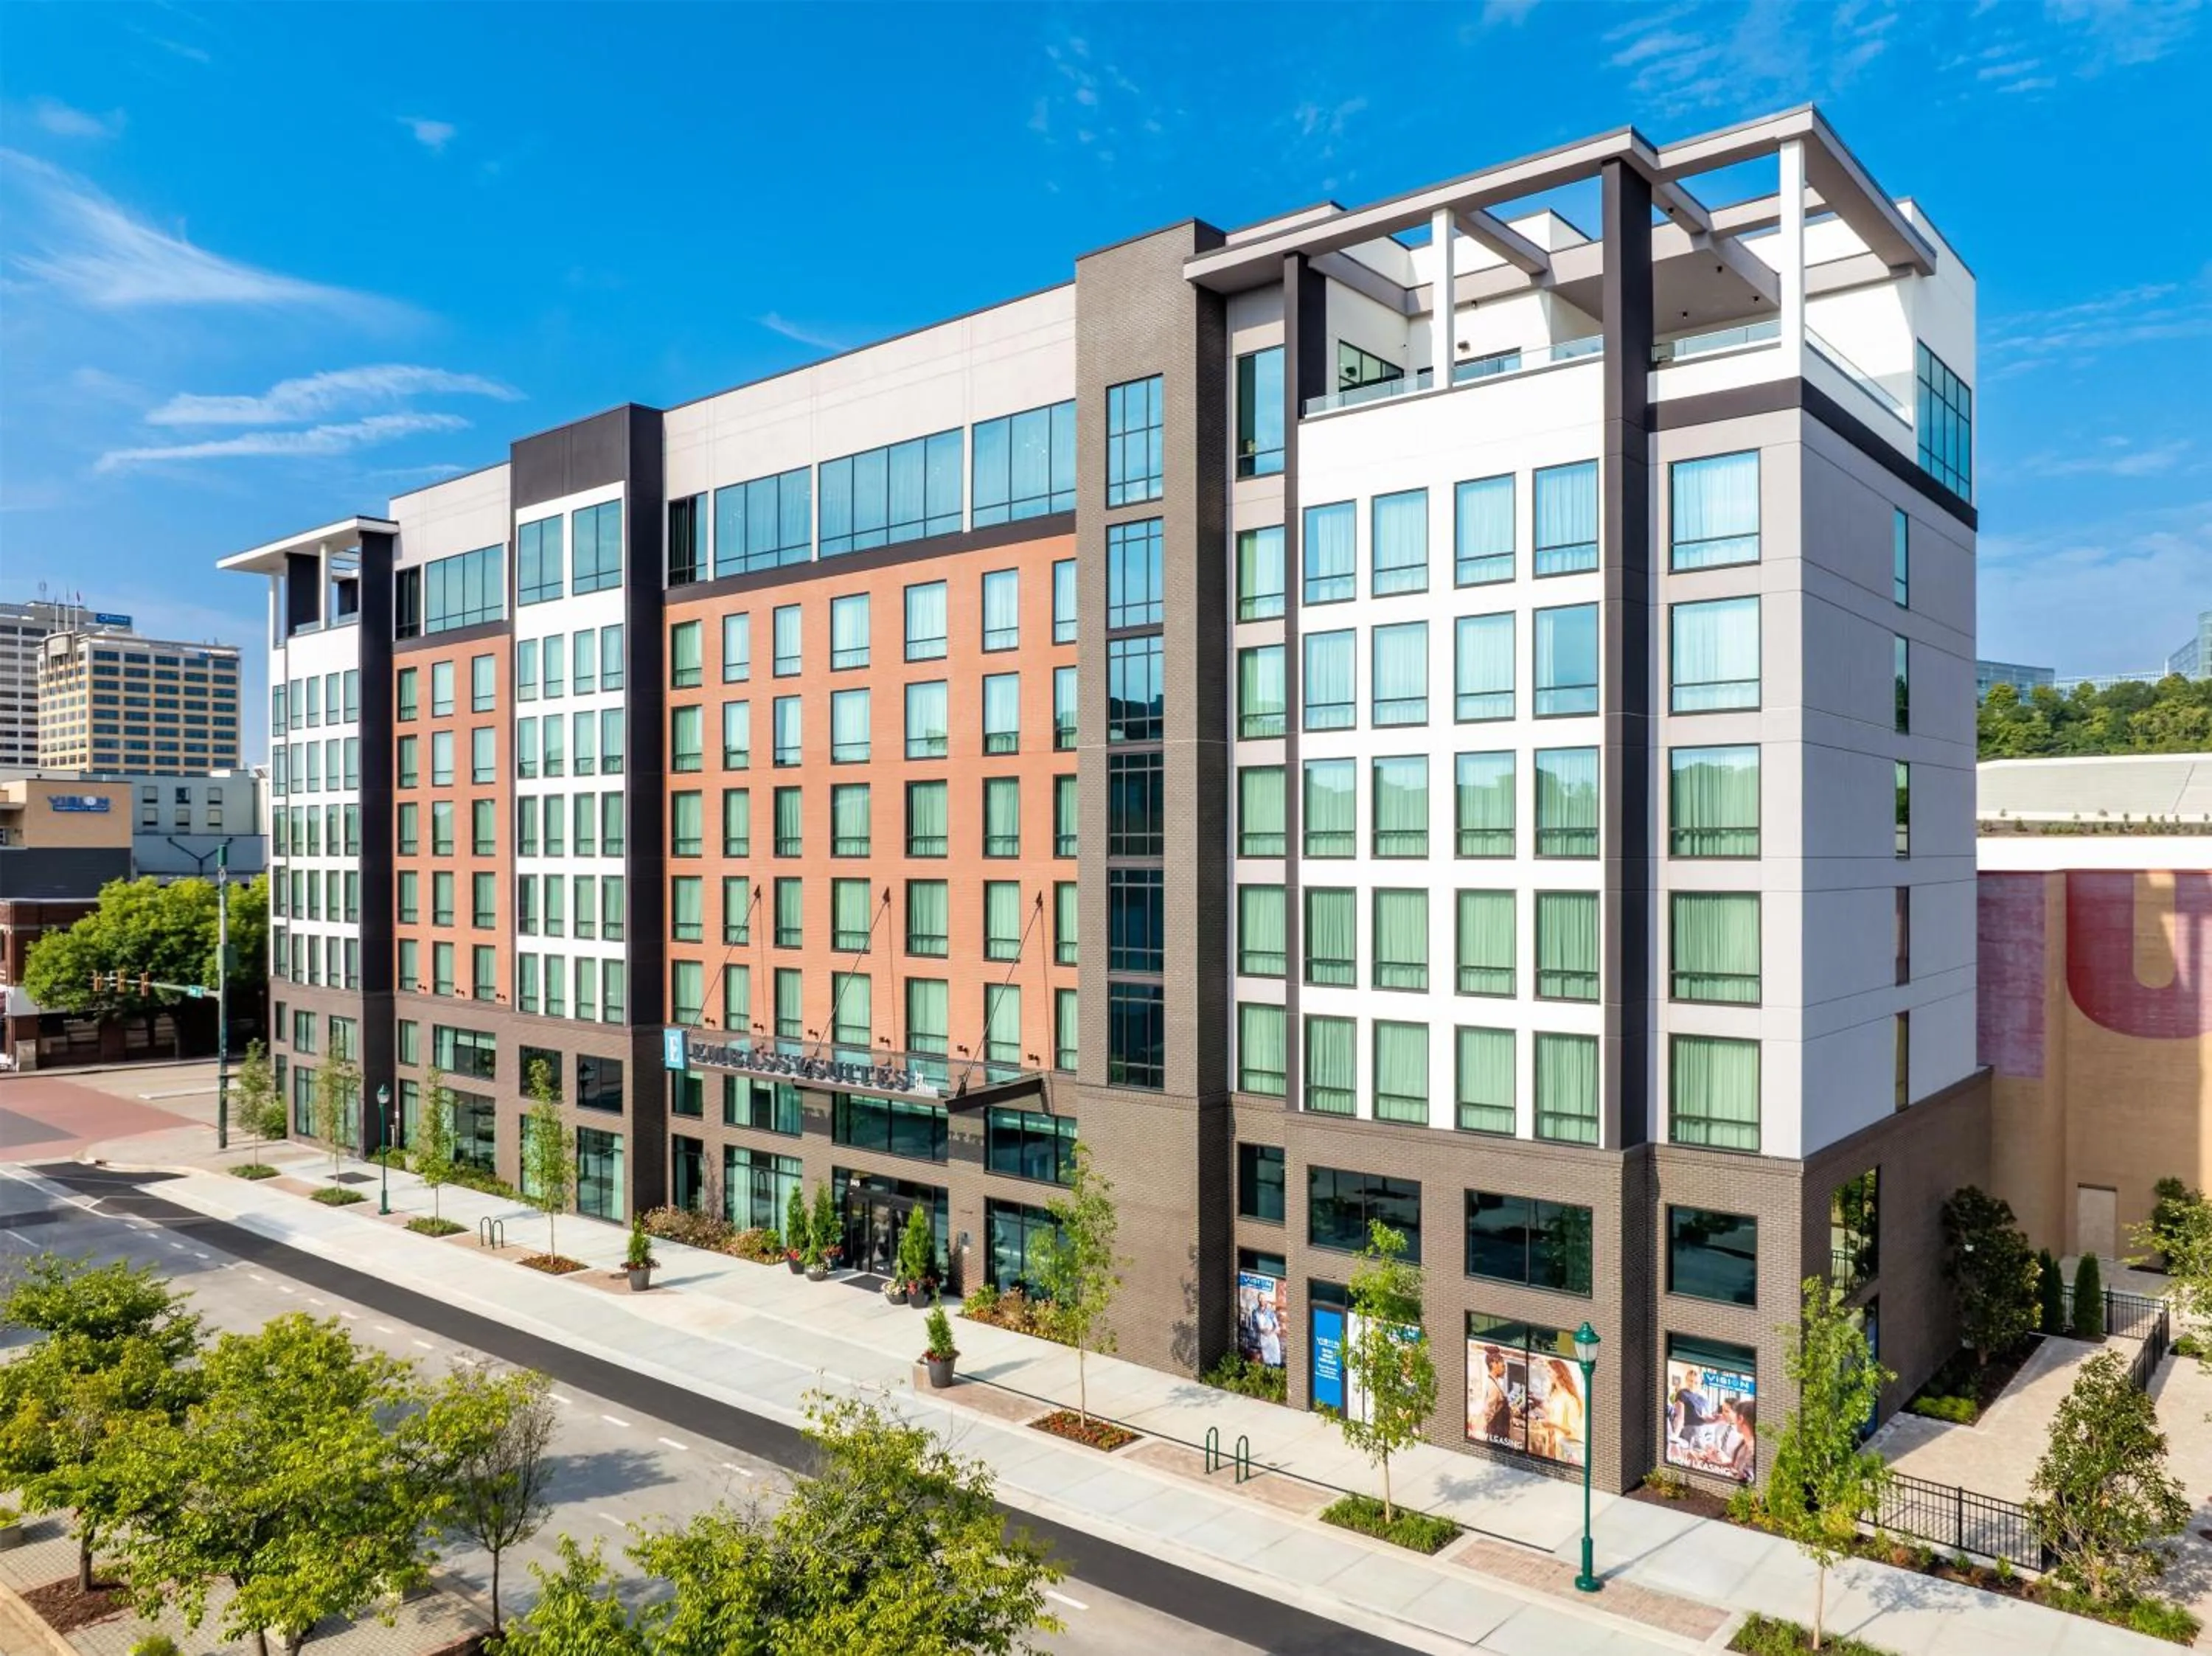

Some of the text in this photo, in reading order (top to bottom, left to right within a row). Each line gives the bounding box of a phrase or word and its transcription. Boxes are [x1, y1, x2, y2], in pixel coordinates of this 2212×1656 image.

[669, 1036, 679, 1062] E
[812, 1059, 911, 1091] SUITES
[1489, 1433, 1523, 1450] LEASING
[1693, 1460, 1732, 1476] LEASING
